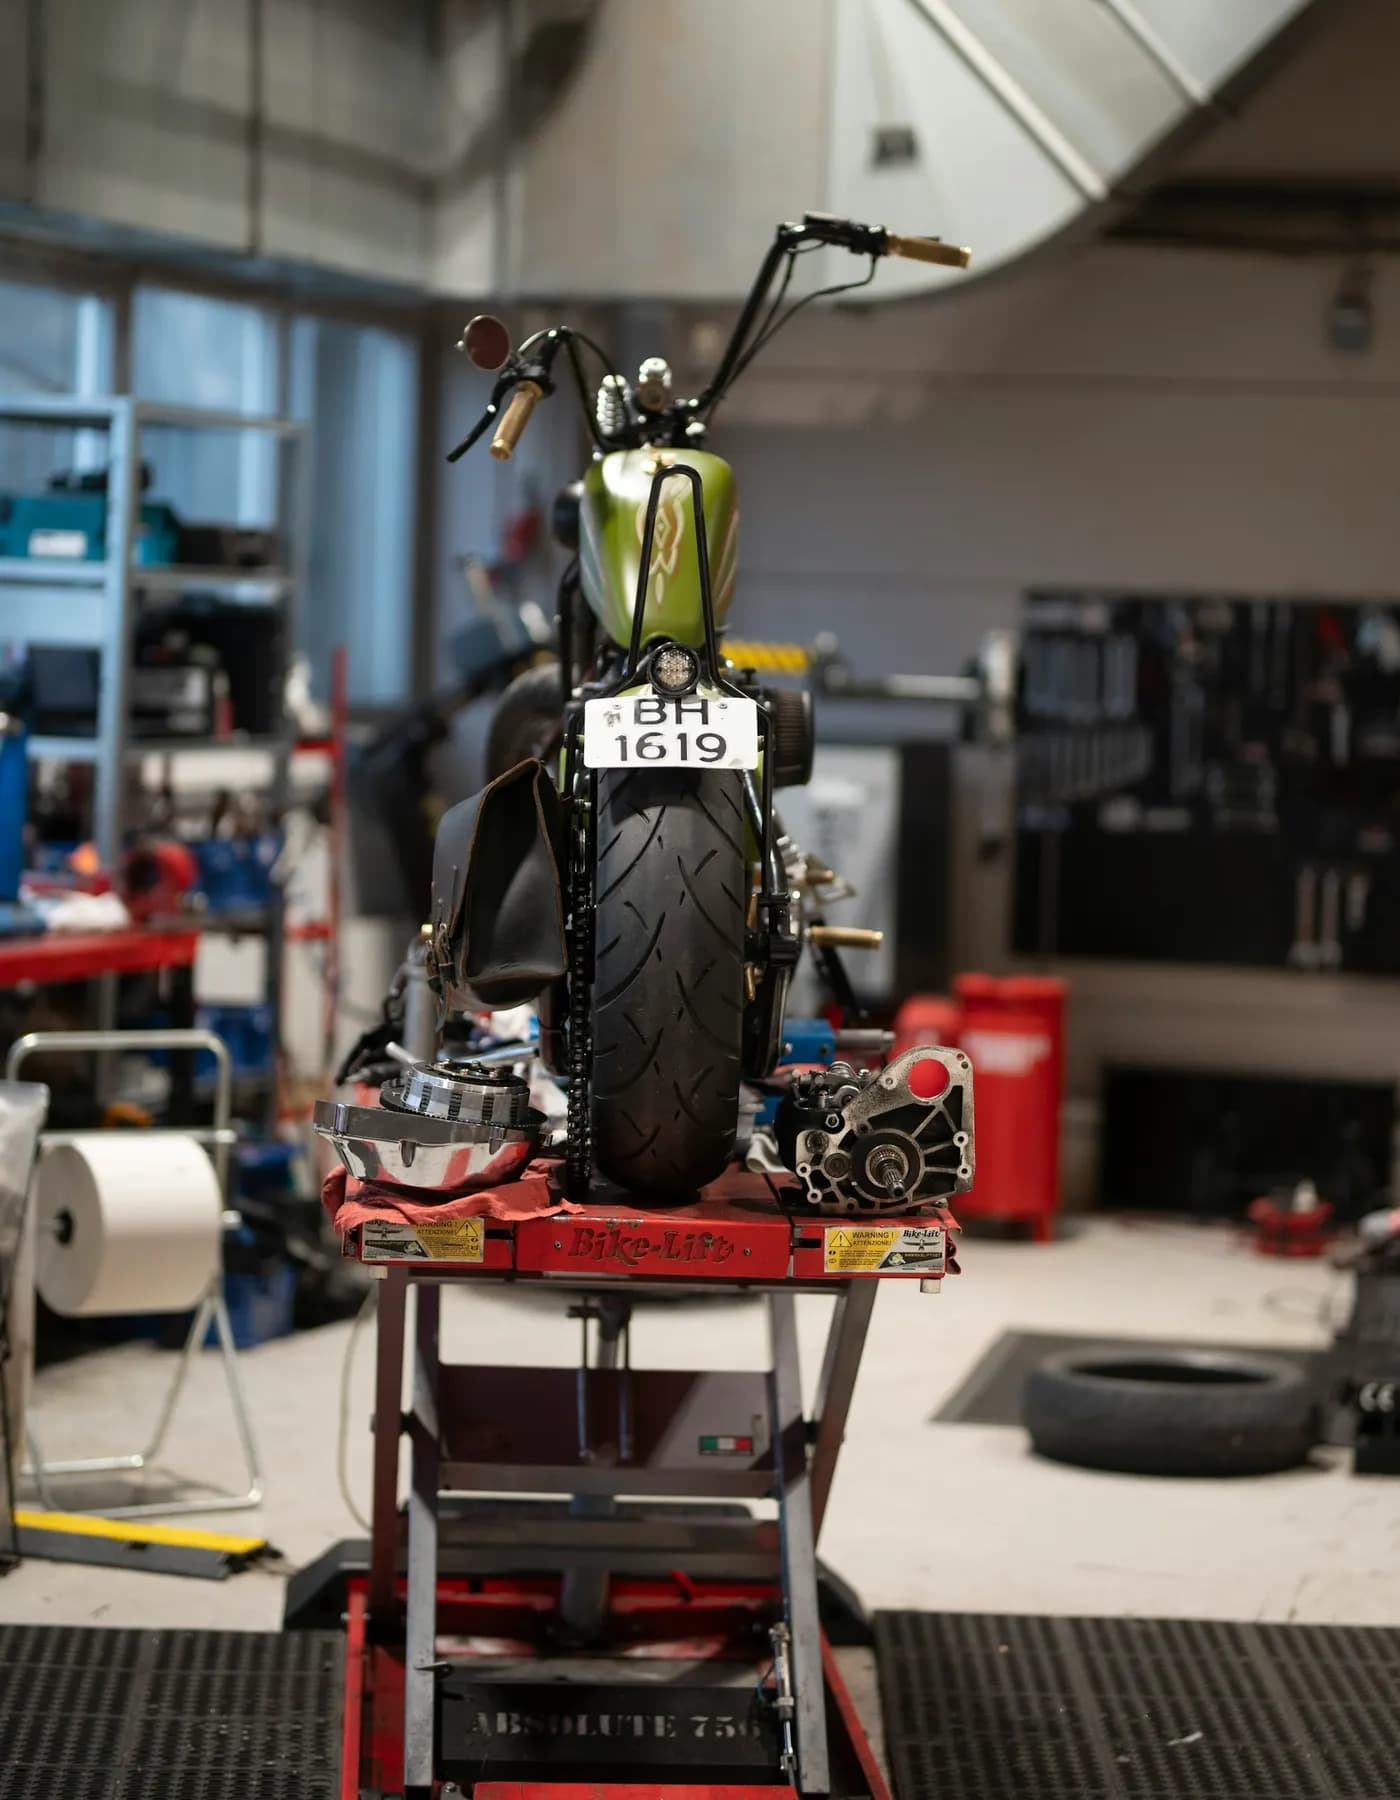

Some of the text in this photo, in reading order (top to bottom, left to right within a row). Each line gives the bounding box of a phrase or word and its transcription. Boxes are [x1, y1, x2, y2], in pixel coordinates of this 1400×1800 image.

[633, 698, 709, 725] BH
[615, 732, 727, 763] 1619
[567, 1227, 735, 1267] Bike-Lift
[852, 1231, 889, 1239] WARNING
[472, 1711, 677, 1738] ABSOLUTE
